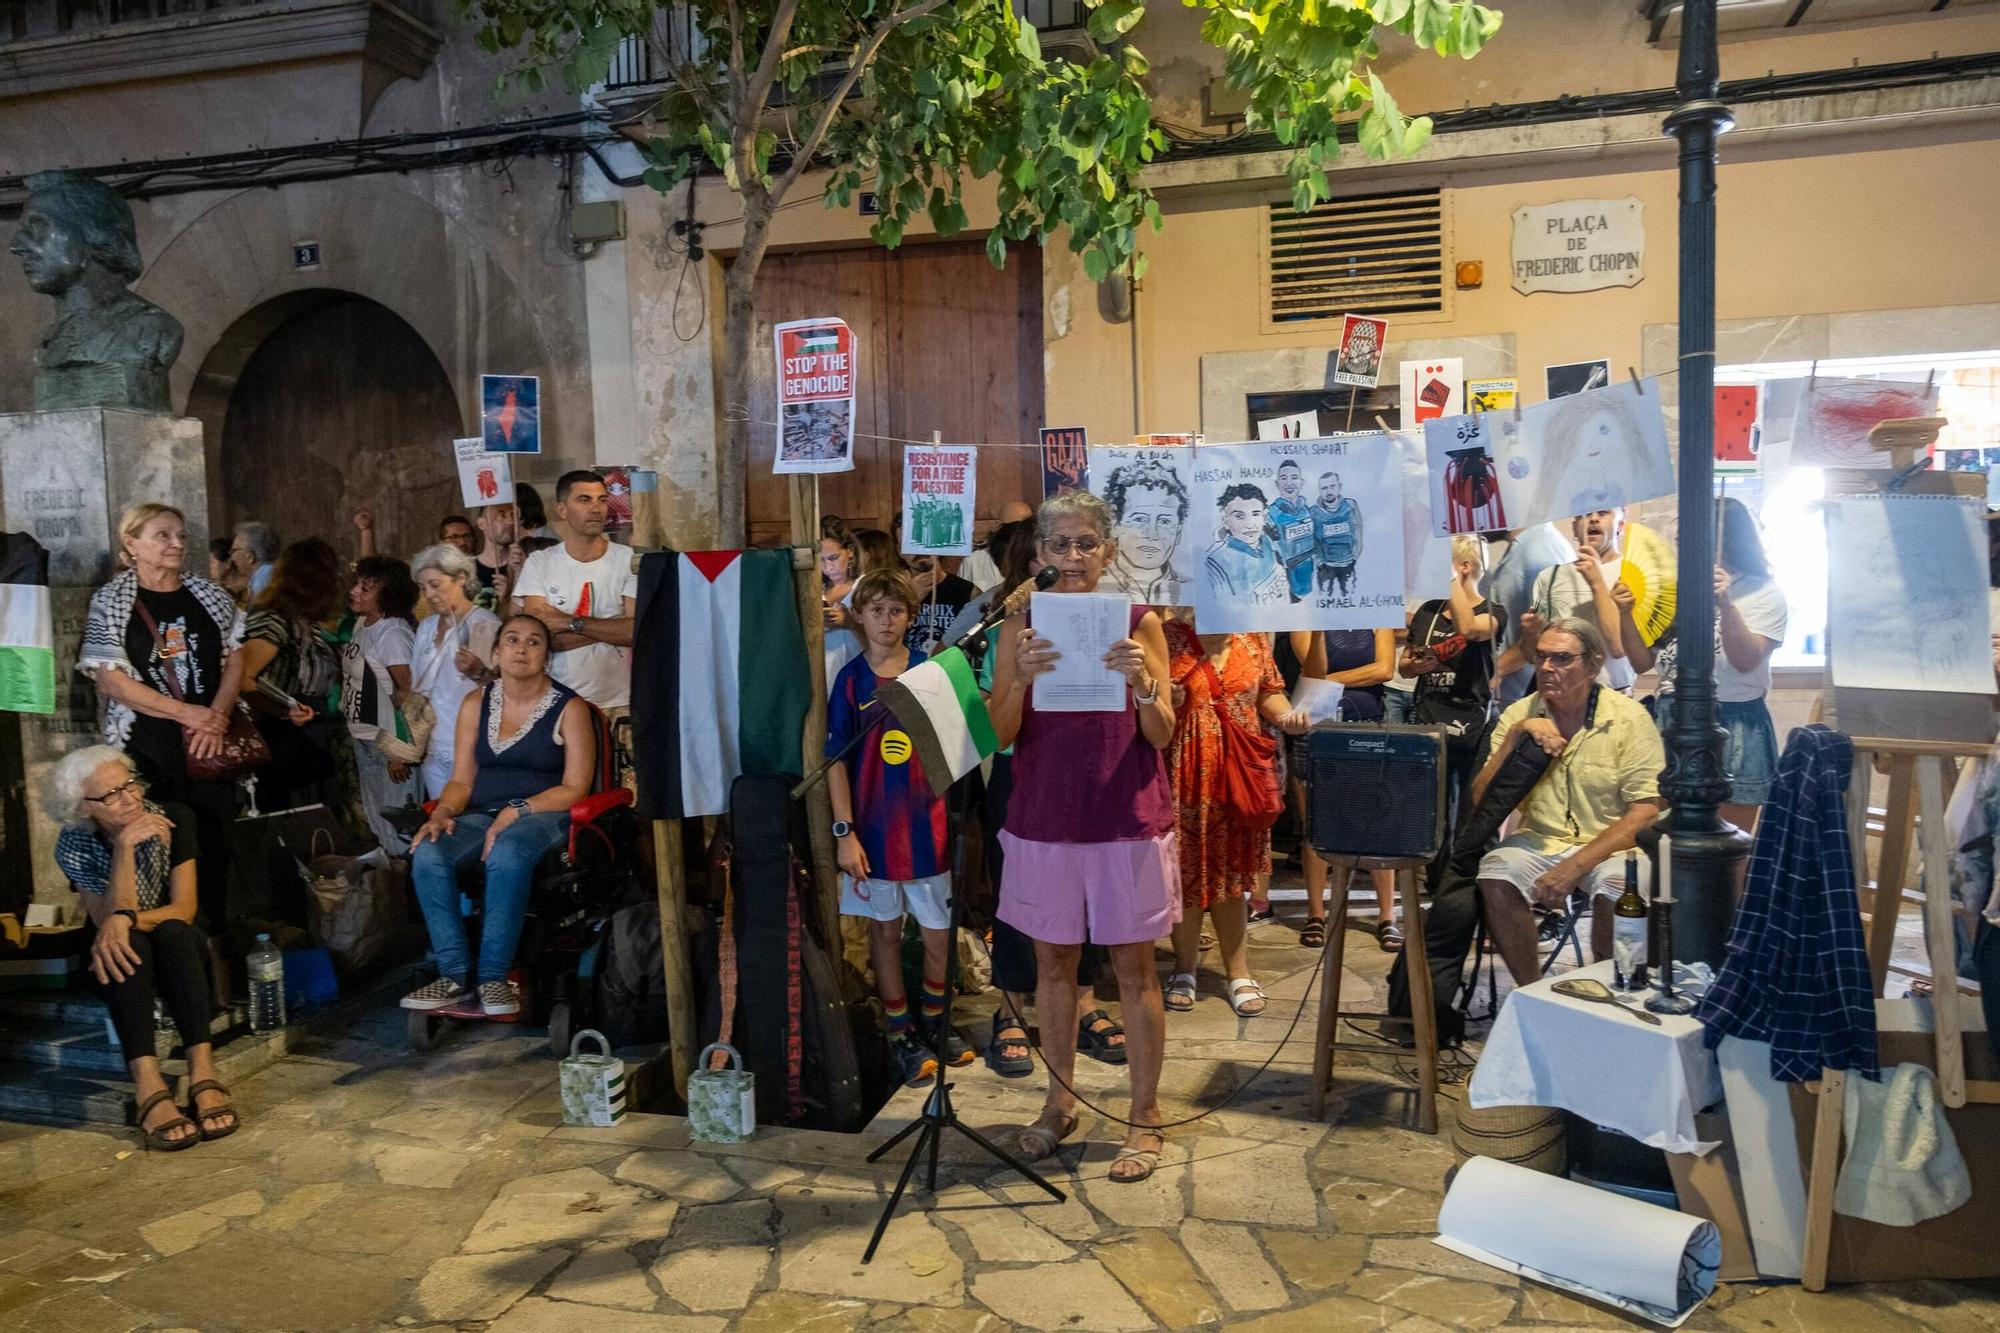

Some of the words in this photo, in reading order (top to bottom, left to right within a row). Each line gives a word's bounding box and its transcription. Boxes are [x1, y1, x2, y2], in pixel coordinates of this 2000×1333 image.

[1546, 215, 1609, 235] PLAÇA
[1567, 237, 1587, 251] DE
[301, 249, 311, 262] 3
[1516, 256, 1584, 278] FREDERIC
[1589, 251, 1640, 272] CHOPIN
[785, 356, 817, 374] STOP
[821, 353, 849, 372] THE
[785, 374, 849, 396] GENOCIDE
[1336, 372, 1349, 382] FREE
[1349, 374, 1377, 385] PALESTINE
[1046, 431, 1086, 473] GAZA
[1270, 445, 1308, 455] HOSSAM
[908, 452, 969, 466] RESISTANCE
[911, 466, 931, 480] FOR
[933, 466, 939, 480] A
[942, 467, 965, 480] FREE
[1194, 468, 1232, 483] HASSAN
[1240, 467, 1273, 479] HAMAD
[911, 480, 964, 494] PALESTINE
[1288, 523, 1313, 536] PRESS
[1316, 597, 1356, 609] ISMAEL
[1348, 739, 1385, 748] Compact
